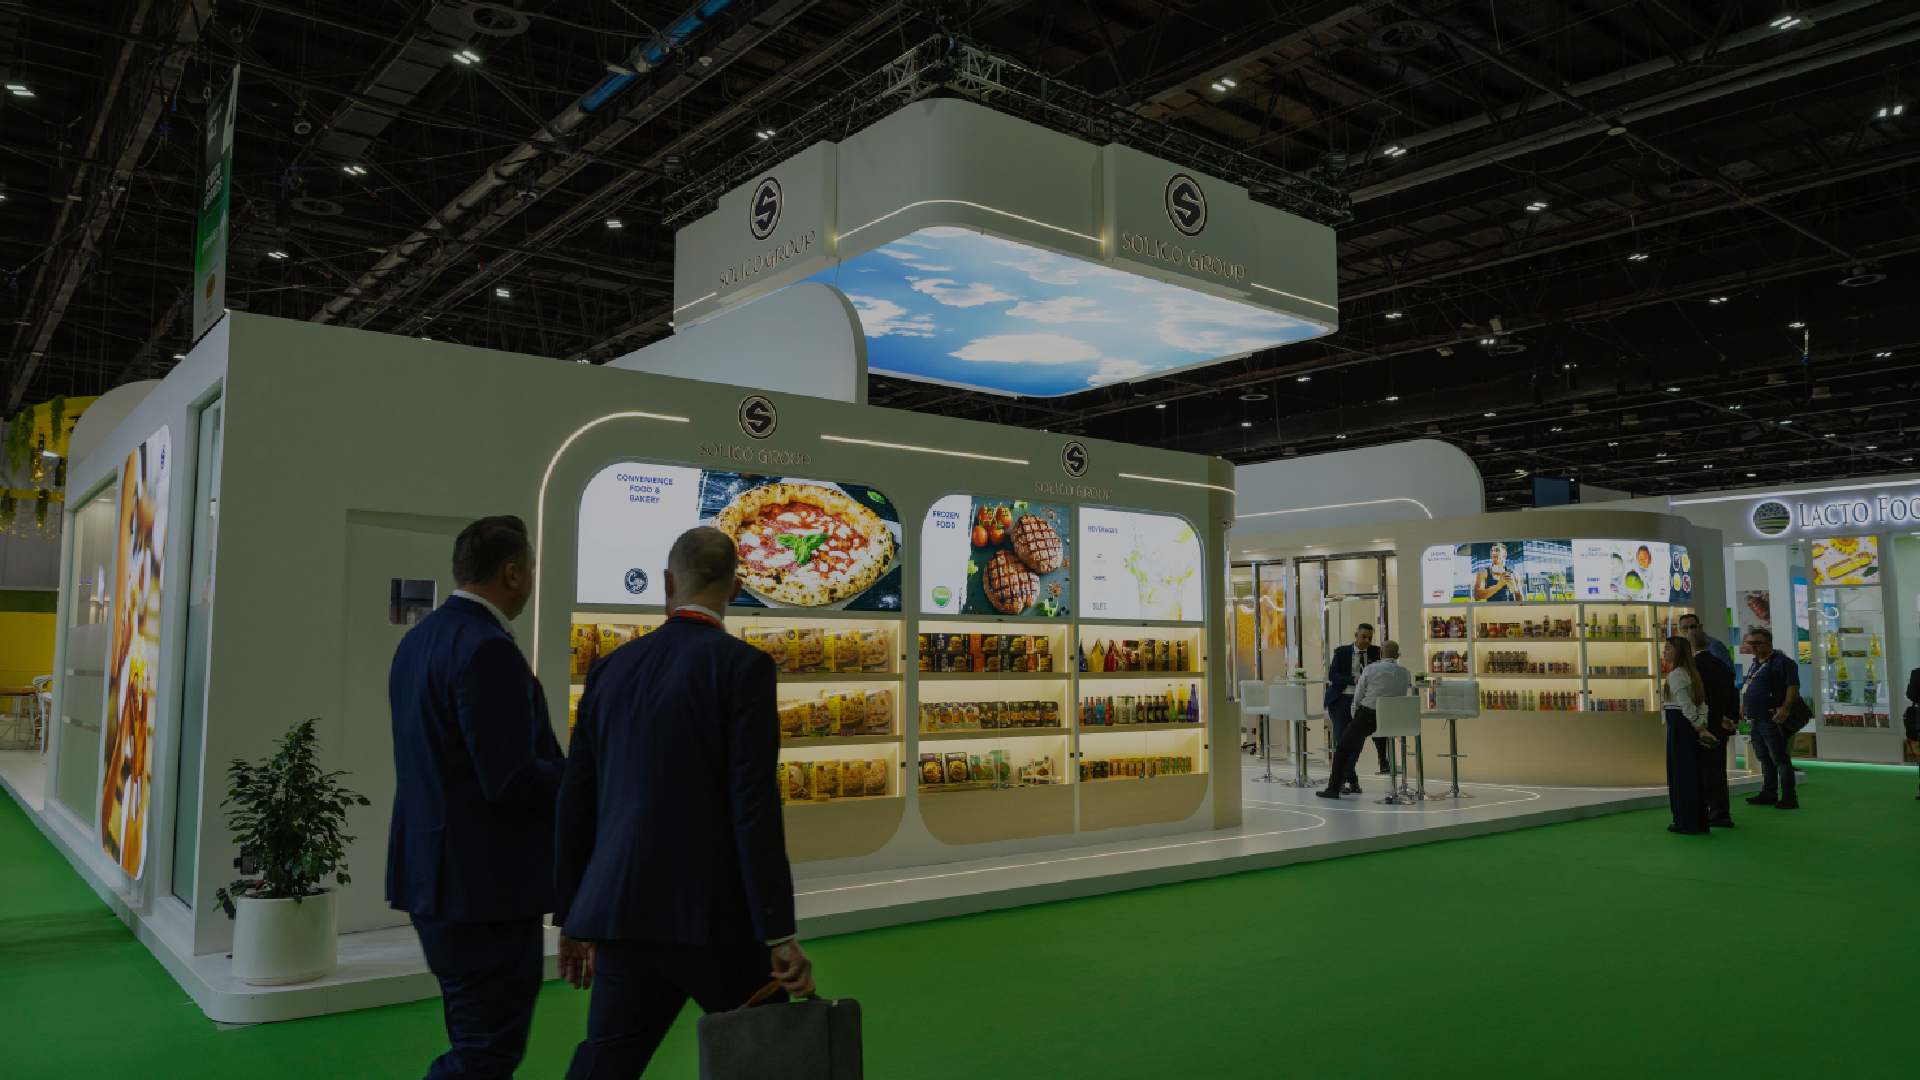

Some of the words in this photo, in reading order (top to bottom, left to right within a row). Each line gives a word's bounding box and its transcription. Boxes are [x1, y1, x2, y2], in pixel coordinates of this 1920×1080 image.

[719, 255, 763, 288] SOLICO
[765, 230, 817, 269] GROUP
[1122, 232, 1184, 263] SOLICO
[1187, 249, 1246, 281] GROUP
[699, 441, 753, 462] SOLICO
[758, 447, 812, 466] GROUP
[616, 473, 673, 485] CONVENIENCE
[629, 485, 653, 493] FOOD
[629, 495, 661, 504] BAKERY
[932, 511, 960, 519] FROZEN
[1799, 501, 1869, 528] LACTO
[936, 521, 956, 529] FOOD
